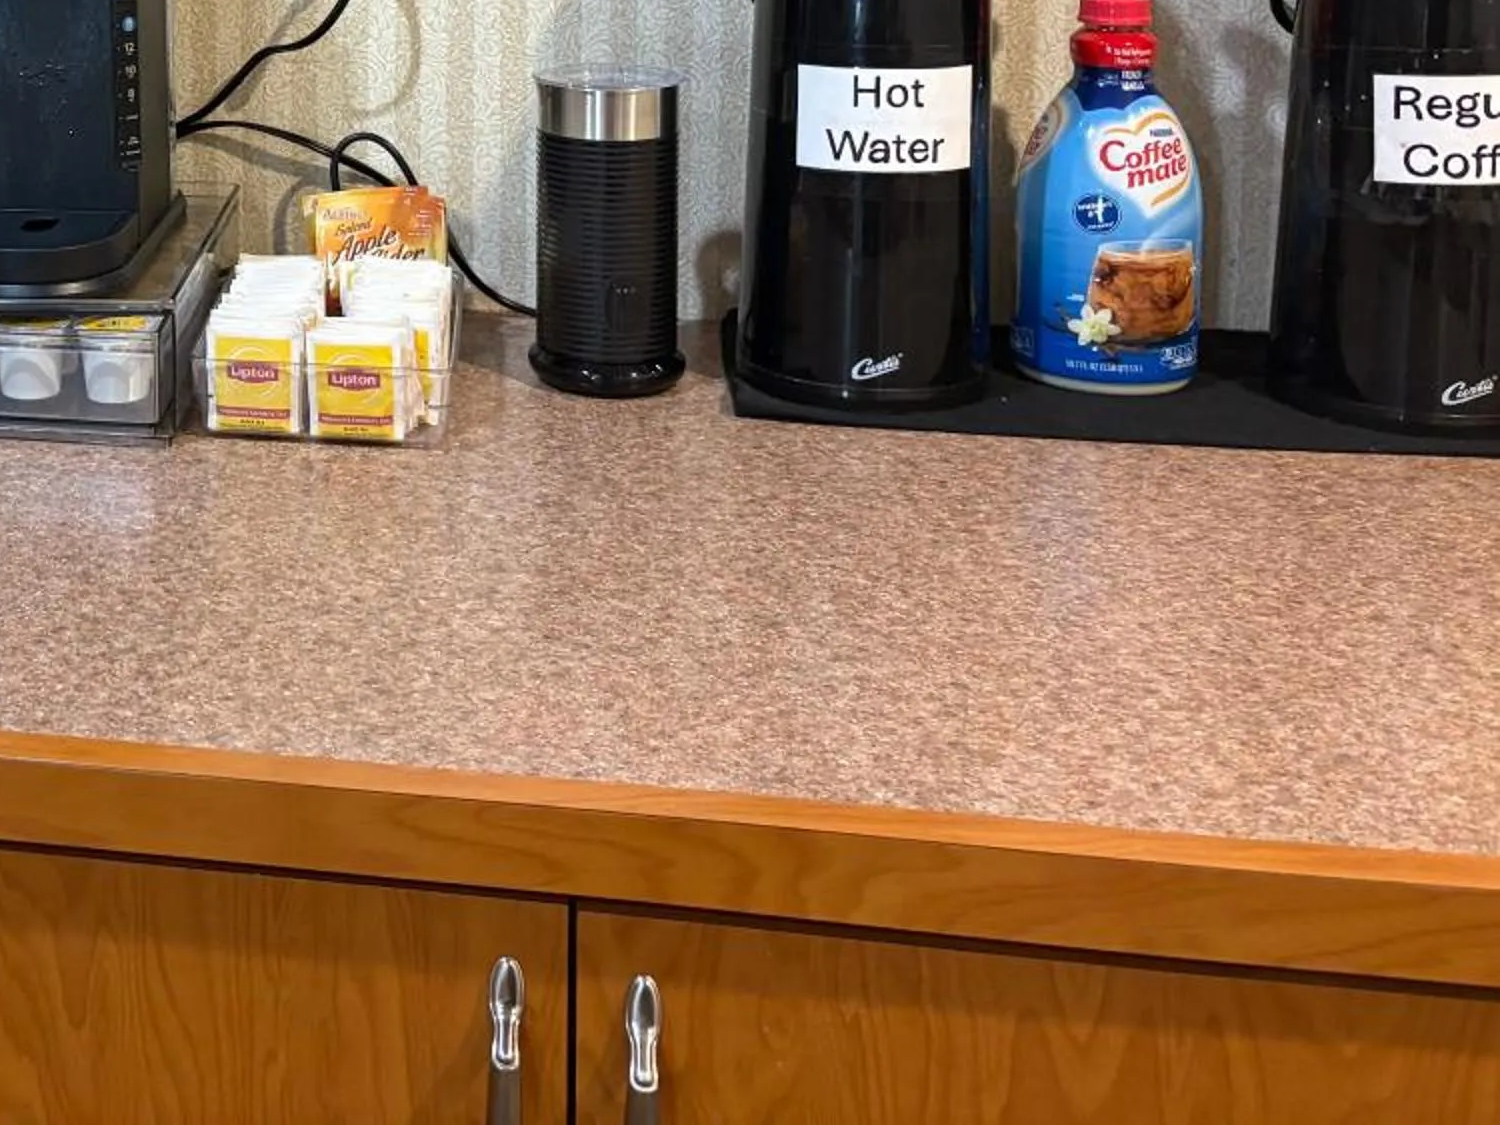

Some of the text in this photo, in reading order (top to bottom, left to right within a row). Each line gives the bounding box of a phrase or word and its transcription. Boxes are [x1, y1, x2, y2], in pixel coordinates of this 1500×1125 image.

[853, 74, 925, 108] Hot
[1393, 85, 1500, 128] Regu
[826, 128, 945, 164] Water
[1099, 137, 1182, 172] Coffee
[1403, 143, 1500, 179] Coff
[1127, 153, 1187, 189] mate
[332, 223, 398, 265] Apple
[231, 365, 275, 380] Lipton
[331, 374, 377, 388] Lipton
